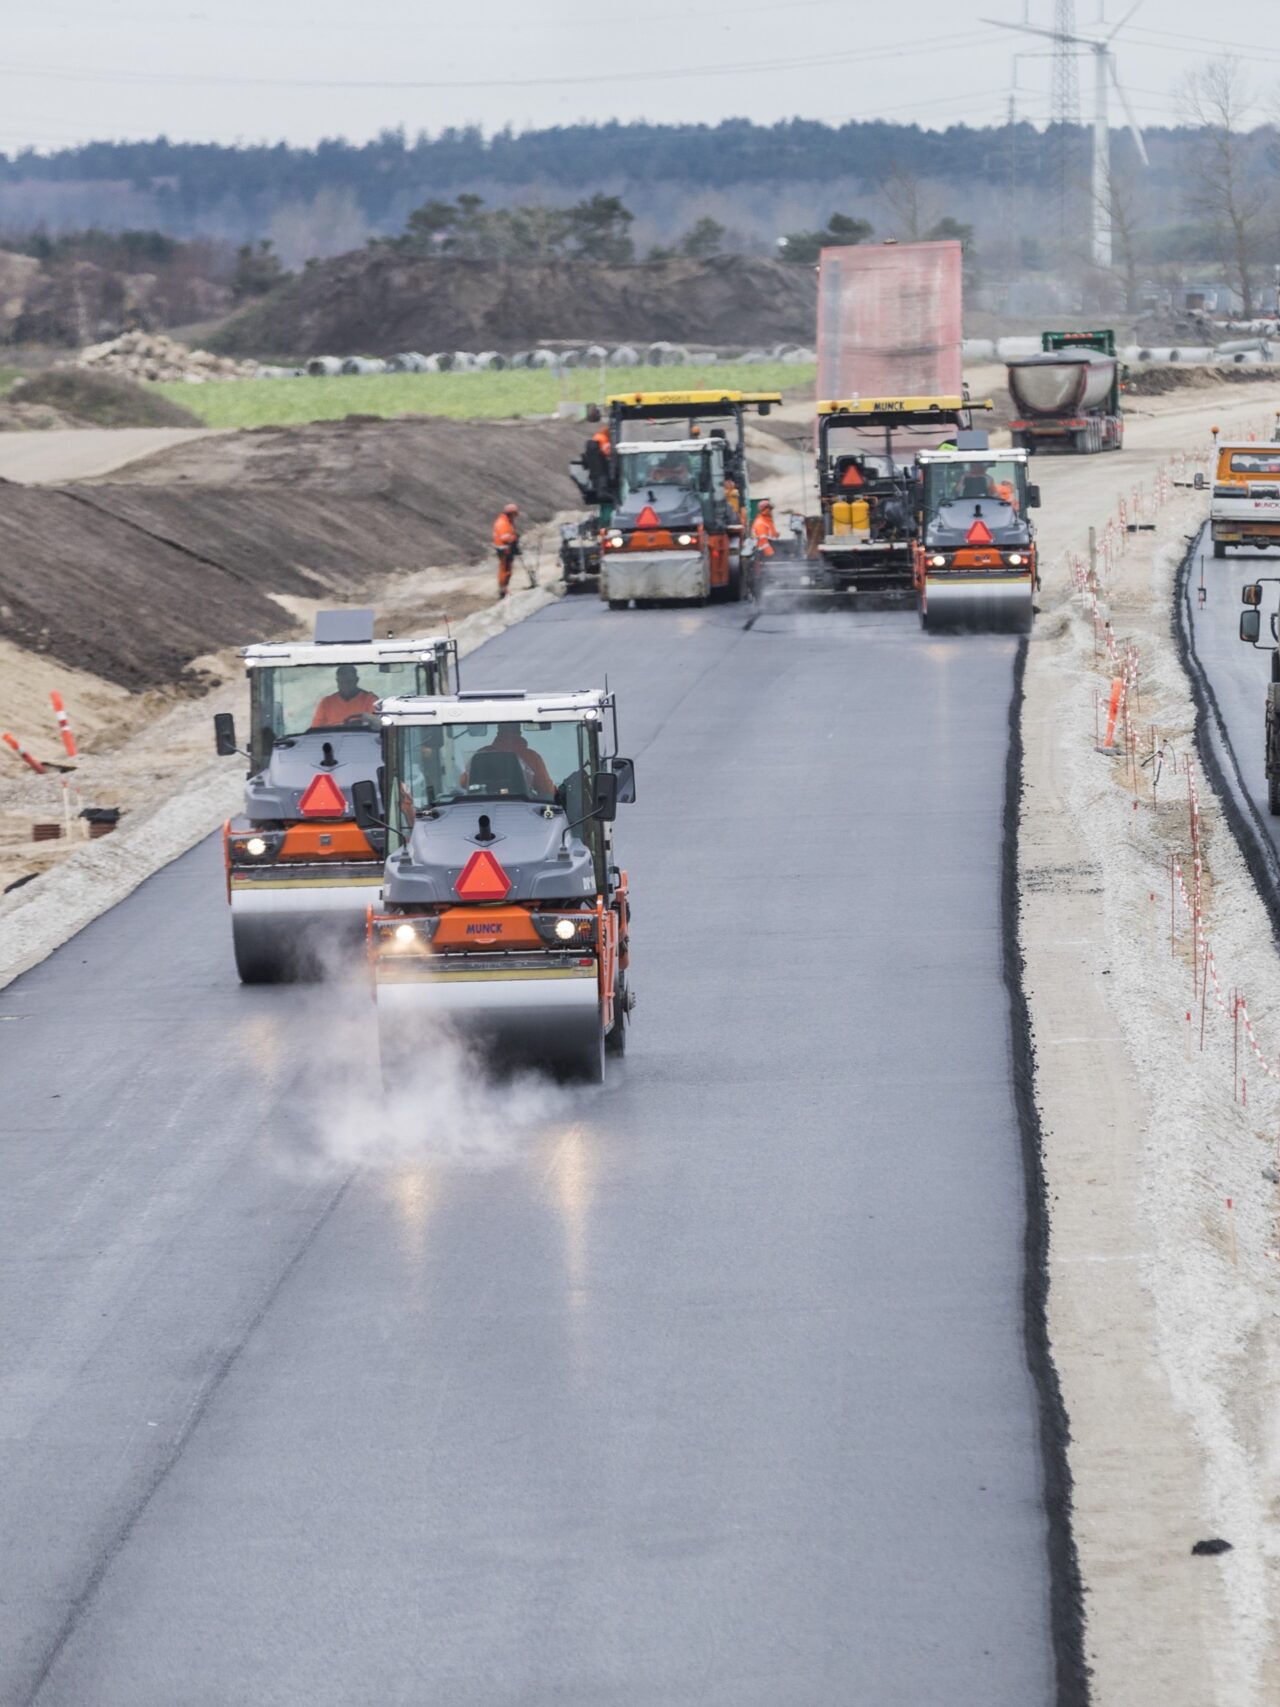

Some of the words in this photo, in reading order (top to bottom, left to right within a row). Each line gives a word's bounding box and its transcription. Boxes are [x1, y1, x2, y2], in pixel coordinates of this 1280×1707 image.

[873, 400, 905, 411] MUNCK
[1254, 501, 1280, 509] MUNCK
[466, 923, 503, 934] MUNCK
